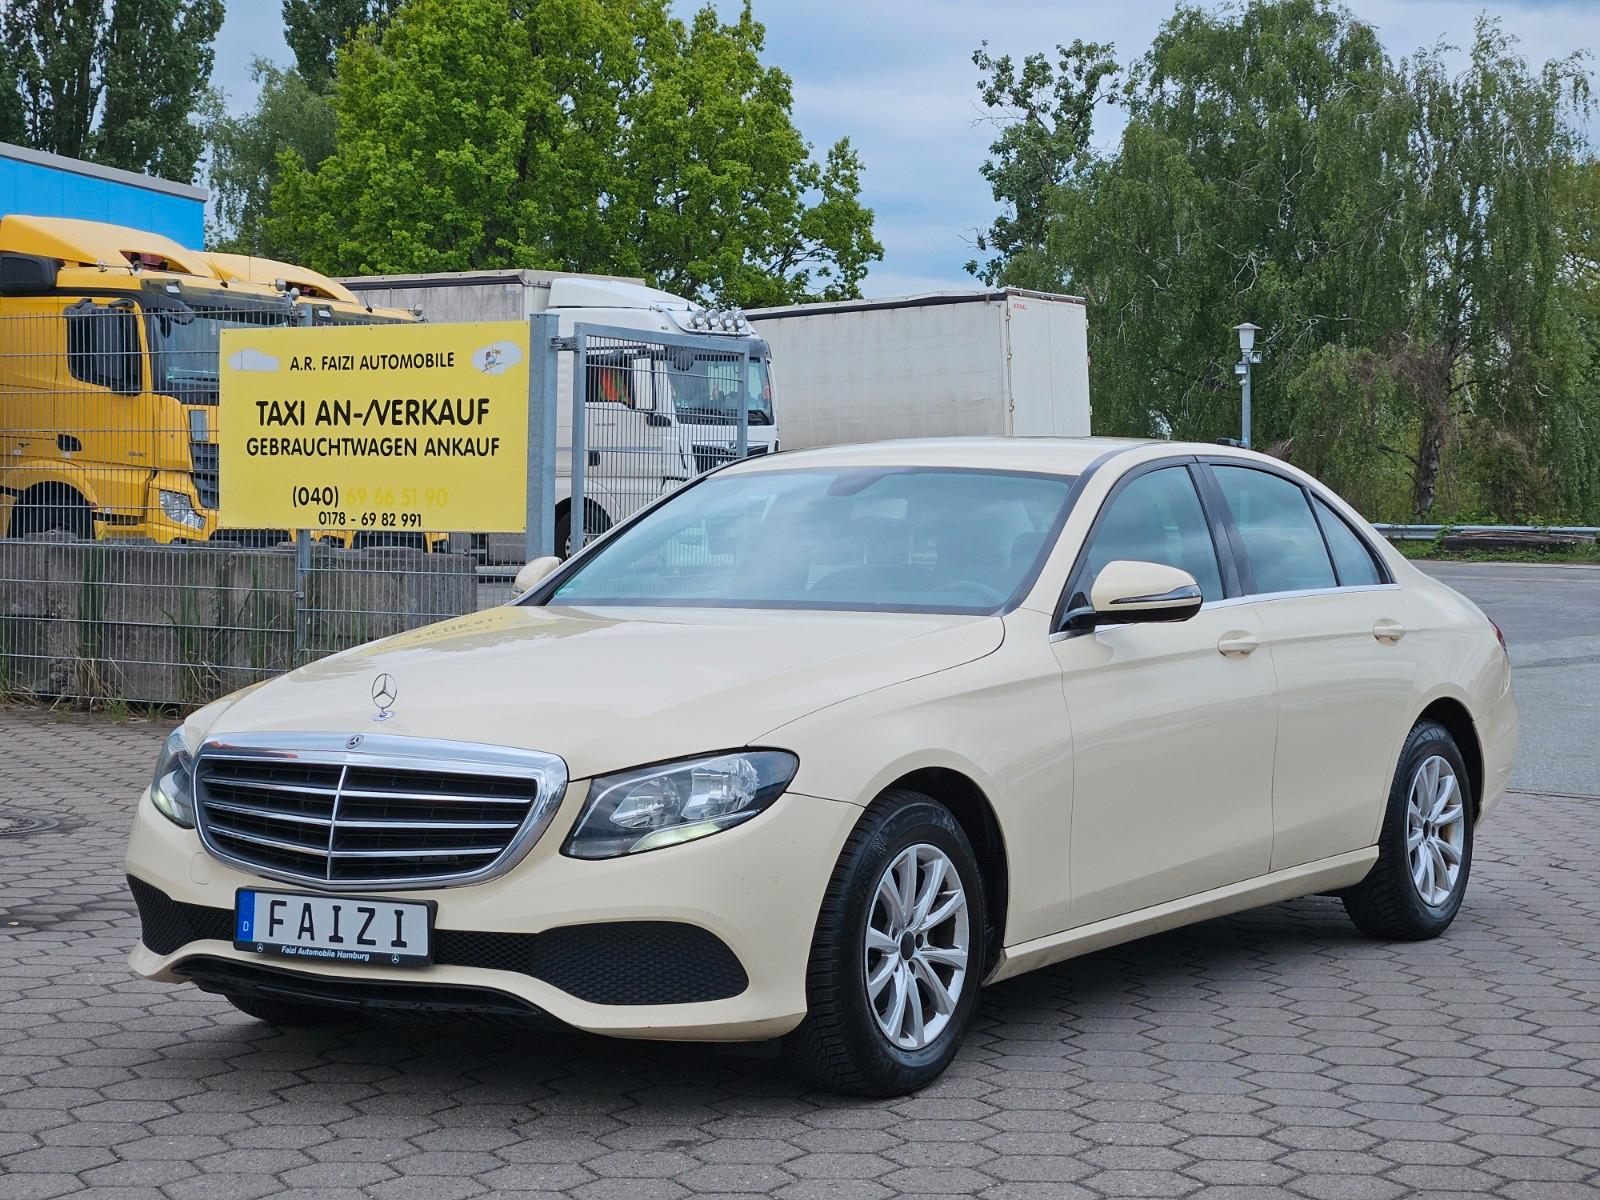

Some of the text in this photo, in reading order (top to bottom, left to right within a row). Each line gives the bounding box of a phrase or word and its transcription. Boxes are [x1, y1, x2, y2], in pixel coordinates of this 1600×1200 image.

[290, 352, 455, 371] A.R. FAIZI AUTOMOBILE
[255, 399, 305, 426] TAXI
[246, 437, 500, 457] GEBRAUCHTWAGEN ANKAUF
[292, 485, 339, 508] (040)
[346, 487, 367, 506] 69
[374, 488, 394, 507] 66
[426, 488, 448, 508] 90
[318, 511, 346, 526] 0178
[361, 512, 377, 527] 69
[381, 512, 396, 527] 82
[401, 513, 422, 528] 991
[242, 921, 250, 932] D
[268, 899, 408, 948] FAIZI
[297, 947, 336, 958] Automobile
[336, 950, 370, 962] Hamburg
